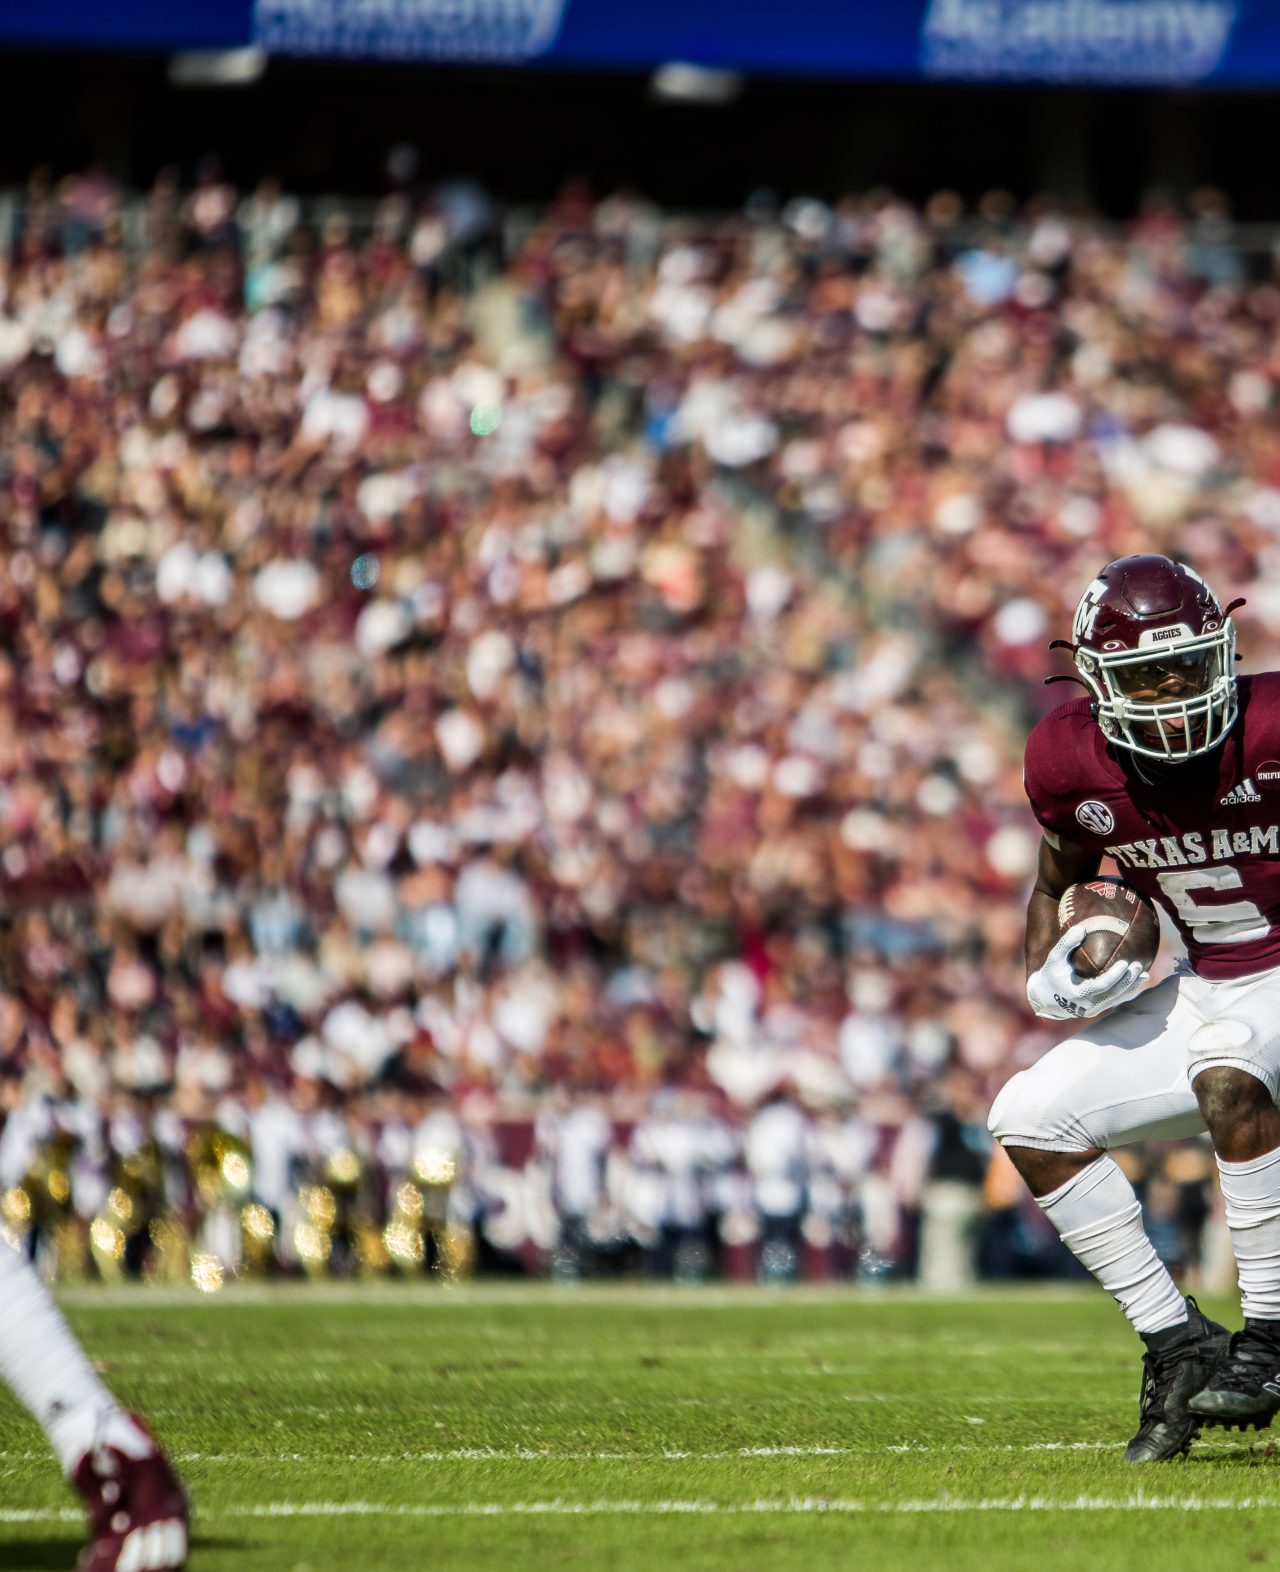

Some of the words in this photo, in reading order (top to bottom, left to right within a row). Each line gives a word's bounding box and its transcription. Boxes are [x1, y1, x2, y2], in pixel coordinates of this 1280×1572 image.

[1152, 627, 1182, 642] AGGIES
[1220, 793, 1262, 806] adidas
[1078, 803, 1111, 833] SEC
[1104, 832, 1207, 868] TEXAS
[1211, 825, 1280, 860] A&M
[1155, 864, 1271, 944] 6
